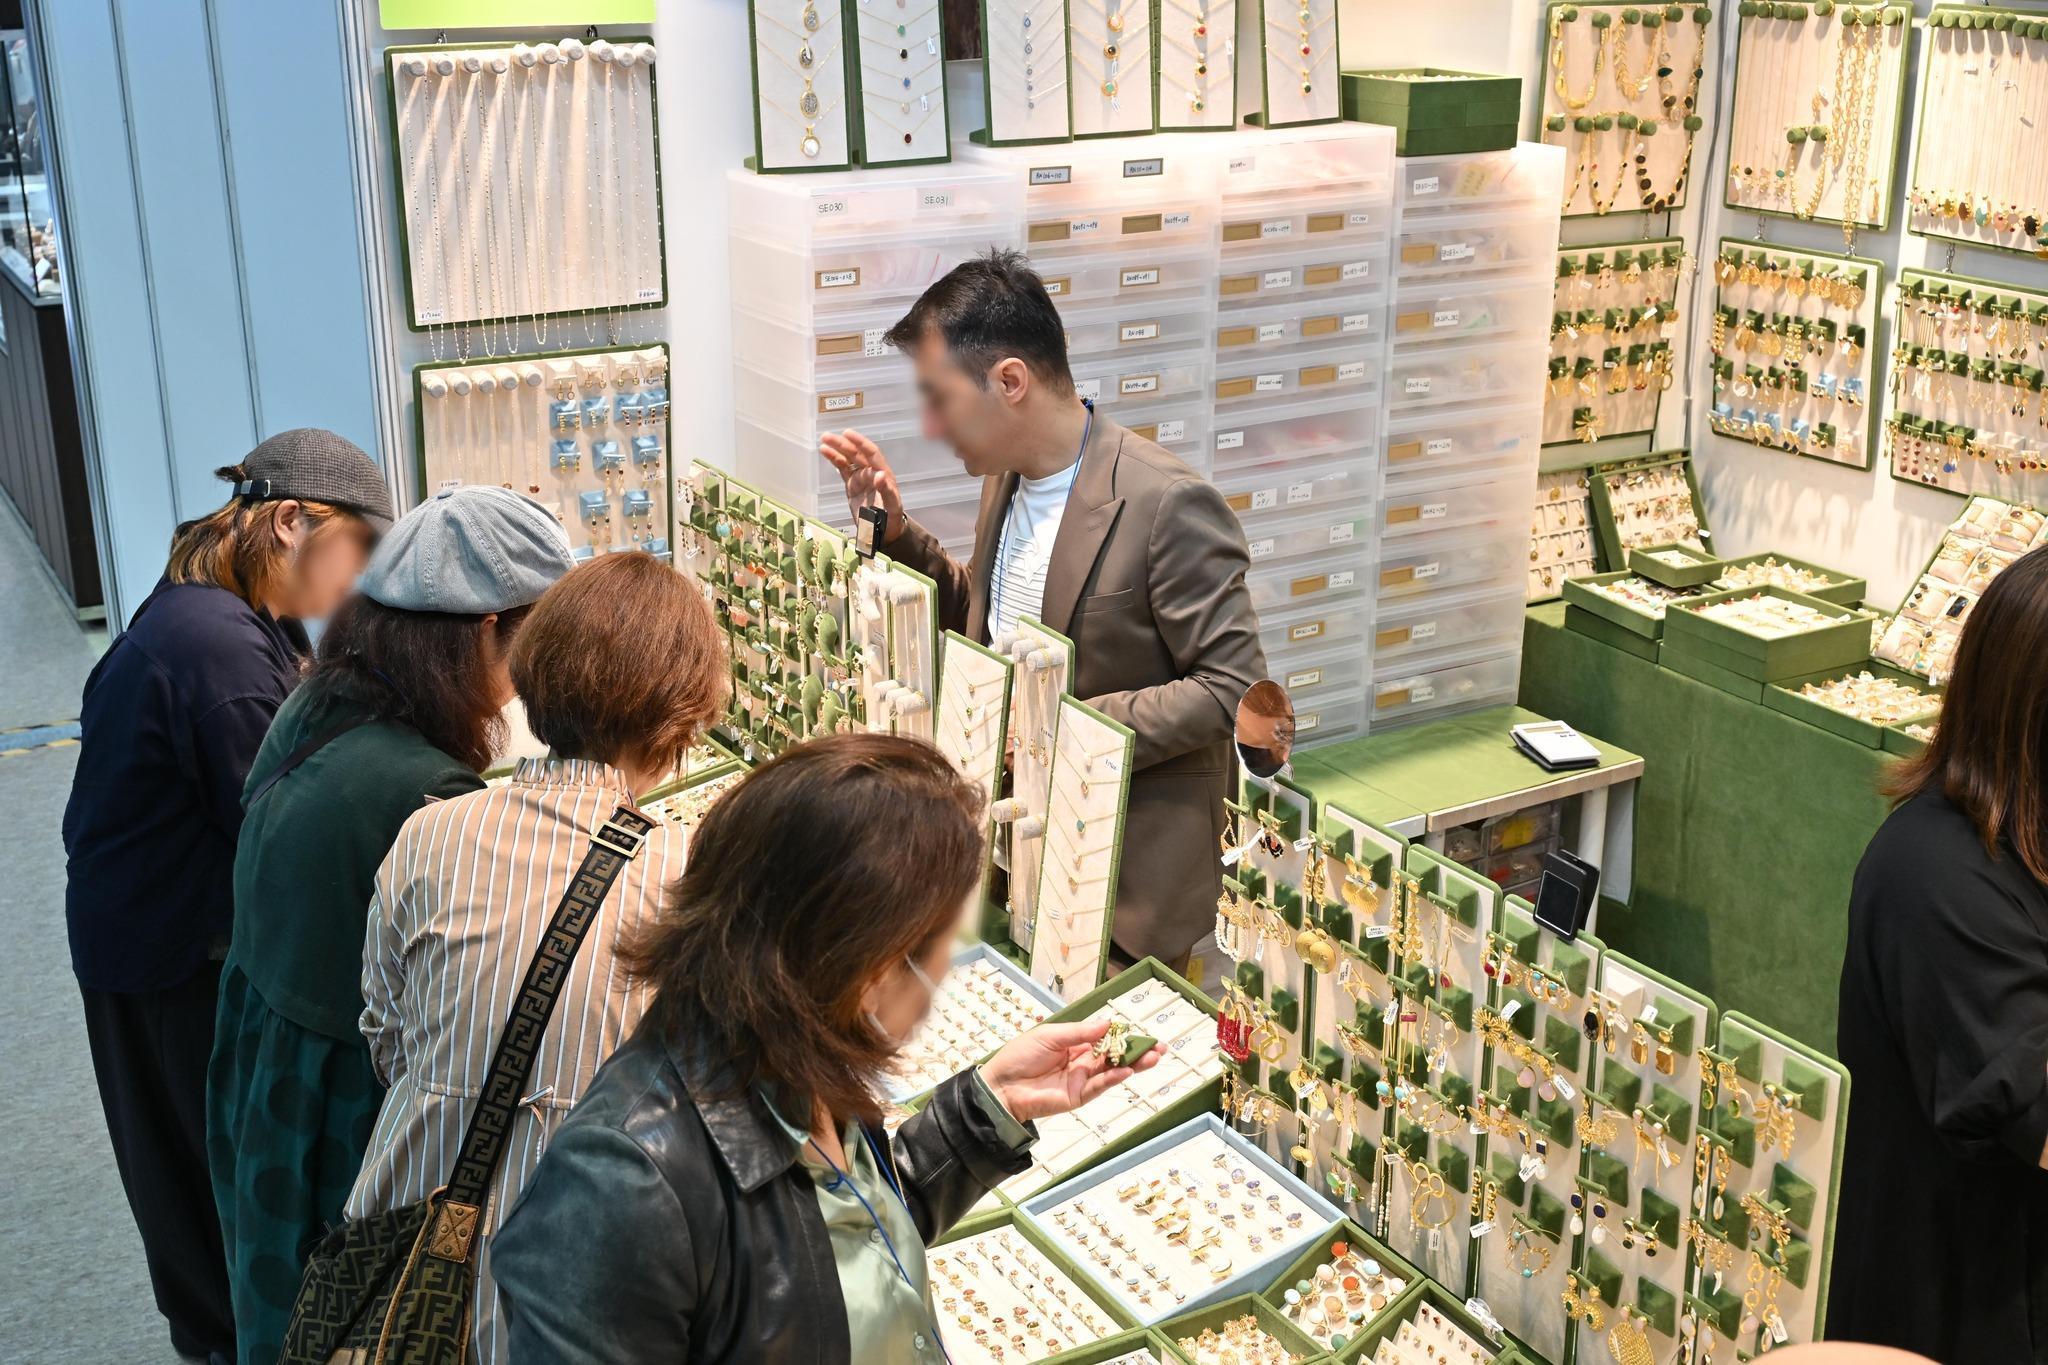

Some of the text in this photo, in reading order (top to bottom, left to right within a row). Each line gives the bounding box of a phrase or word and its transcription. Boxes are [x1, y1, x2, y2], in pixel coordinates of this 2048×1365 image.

[924, 196, 949, 206] SE031
[818, 202, 844, 213] SE030
[828, 396, 850, 406] SN005
